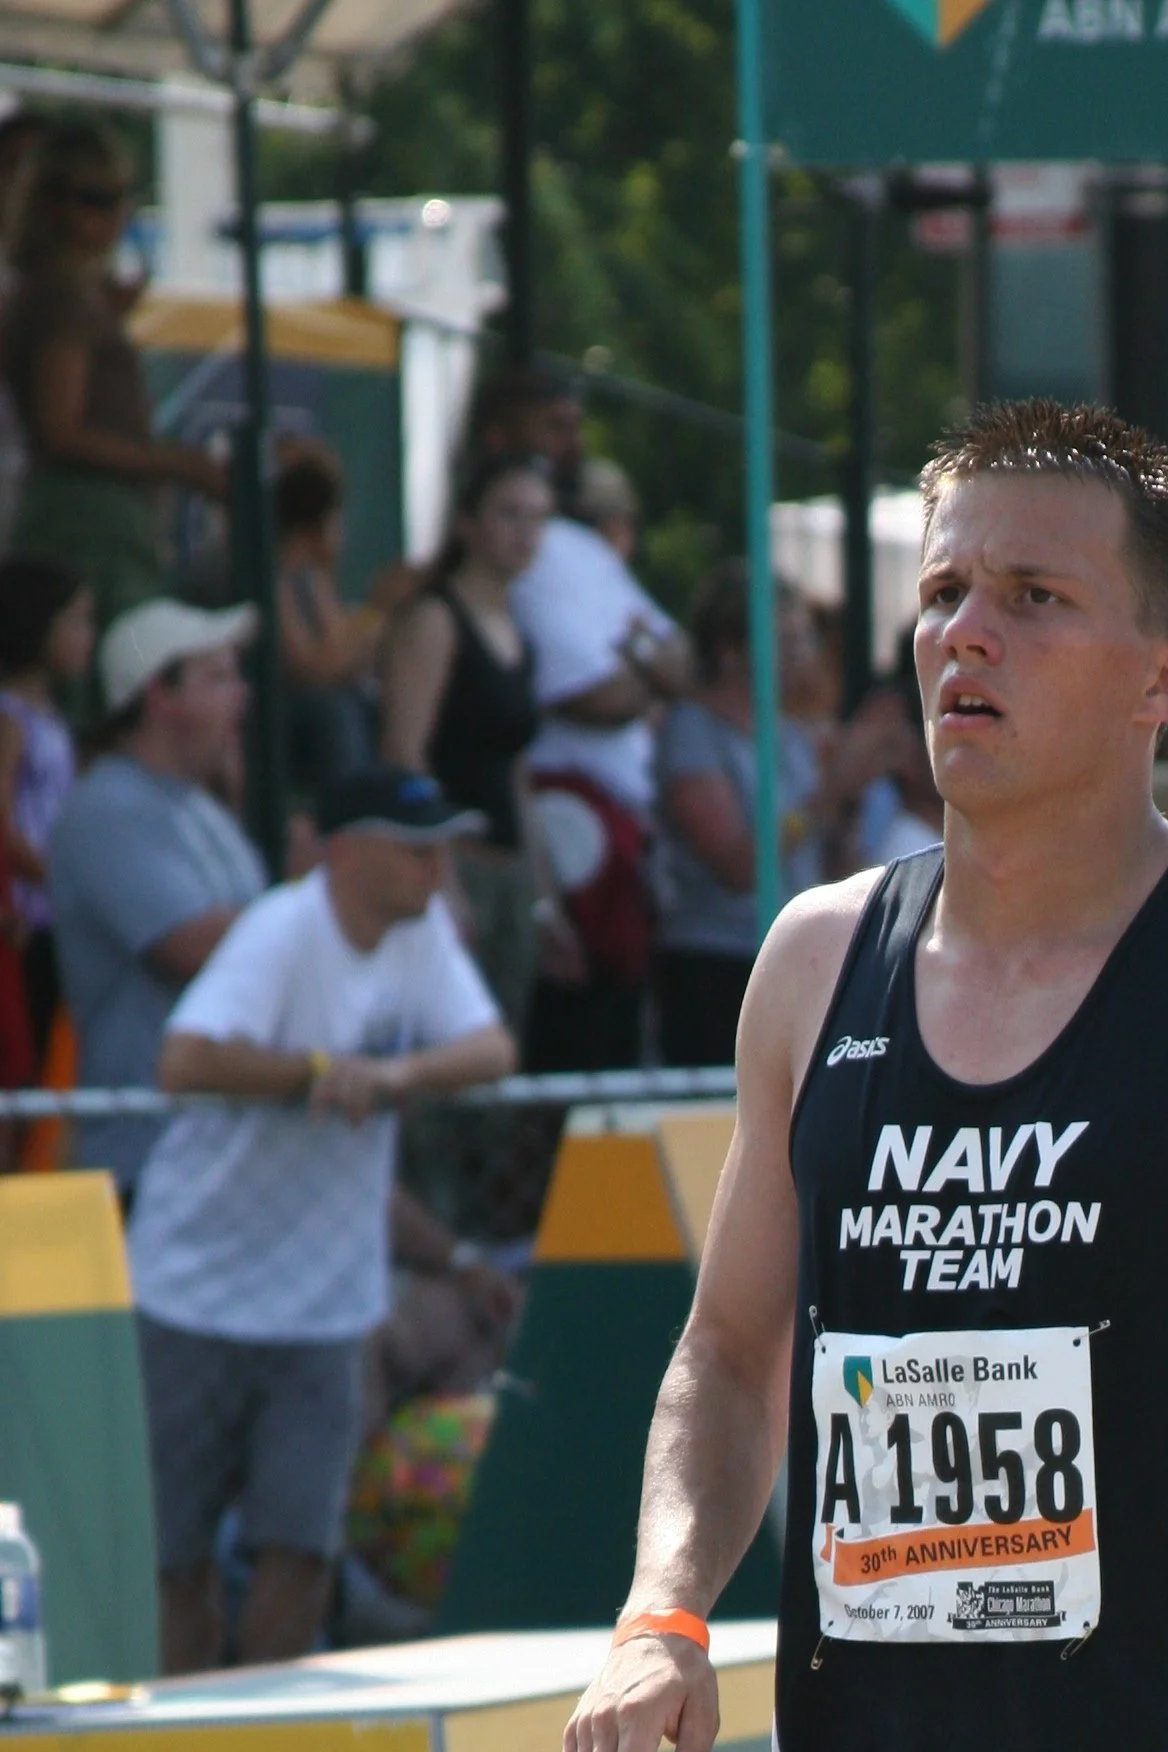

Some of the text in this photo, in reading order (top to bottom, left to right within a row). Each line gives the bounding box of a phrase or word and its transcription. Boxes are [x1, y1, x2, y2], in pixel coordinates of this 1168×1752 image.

[1037, 0, 1143, 42] ABN
[867, 1121, 1090, 1192] NAVY
[839, 1200, 1101, 1250] MARATHON
[900, 1248, 1024, 1291] TEAM
[881, 1354, 1038, 1384] LaSalle Bank
[886, 1391, 956, 1408] ABN AMRO
[820, 1407, 1084, 1525] A 1958
[860, 1526, 1073, 1574] 30th ANNIVERSARY
[894, 1605, 903, 1621] 7,
[907, 1604, 935, 1619] 2007
[985, 1618, 1048, 1627] ANNIVERSARY
